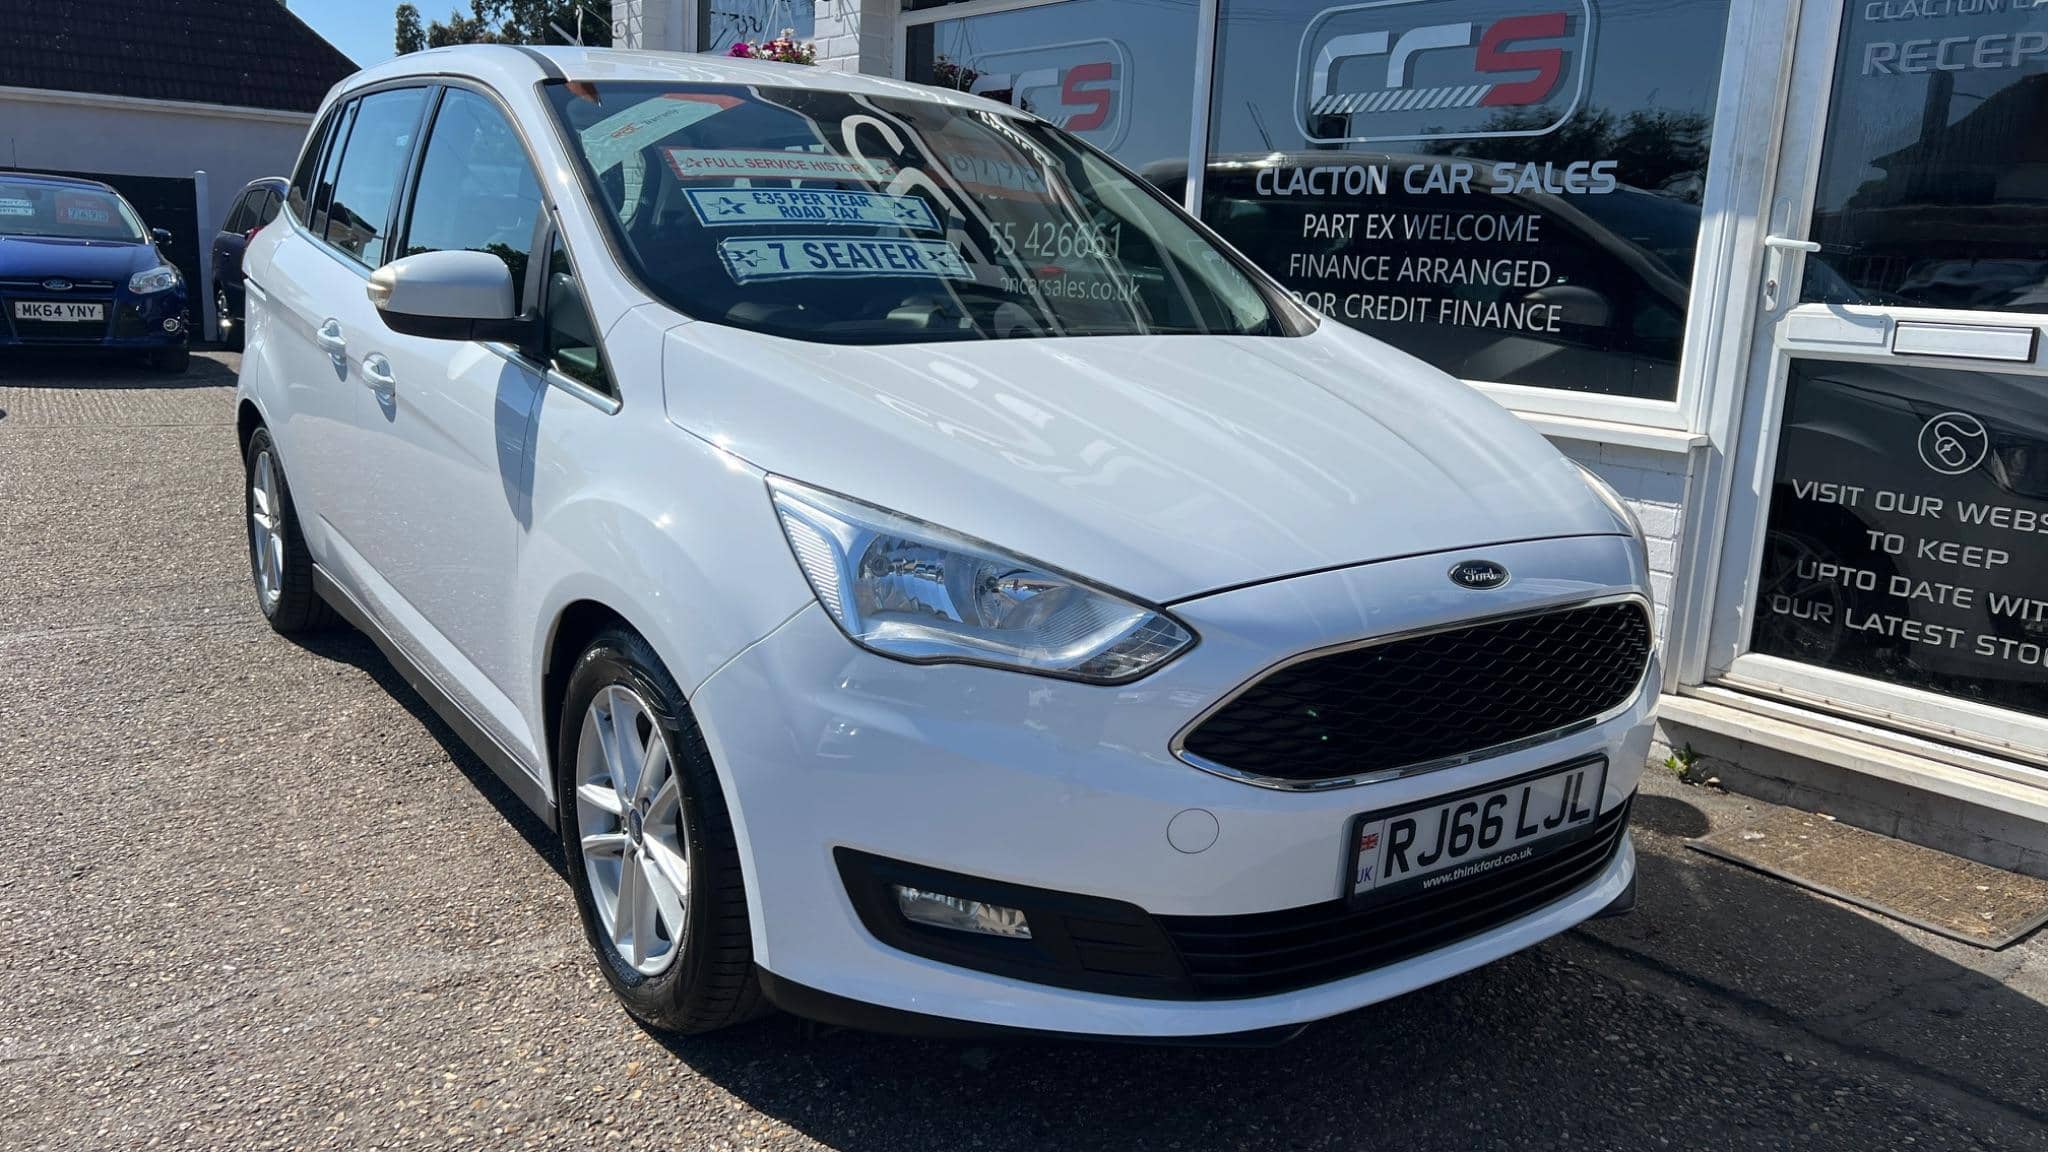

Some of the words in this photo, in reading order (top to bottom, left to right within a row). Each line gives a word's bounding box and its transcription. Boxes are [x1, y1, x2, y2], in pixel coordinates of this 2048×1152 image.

[1864, 0, 1999, 21] CLACTON
[1861, 31, 2048, 75] RECEP
[703, 157, 744, 169] FULL
[744, 158, 806, 171] SERVICE
[812, 160, 868, 175] HISTOR
[1255, 165, 1388, 196] CLACTON
[1403, 162, 1474, 195] CAR
[1491, 160, 1618, 194] SALES
[752, 193, 785, 205] £35
[790, 193, 821, 206] PER
[824, 194, 873, 208] YEAR
[779, 205, 826, 219] ROAD
[830, 206, 864, 220] TAX
[1024, 222, 1121, 259] 426661
[1303, 214, 1359, 239] PART
[1366, 214, 1395, 239] EX
[1403, 214, 1541, 242] WELCOME
[767, 243, 789, 270] 7
[803, 242, 928, 271] SEATER
[1289, 254, 1391, 281] FINANCE
[1397, 256, 1551, 287] ARRANGED
[22, 304, 62, 317] MK64
[67, 305, 96, 318] YNY
[1345, 294, 1431, 323] CREDIT
[1439, 299, 1563, 332] FINANCE
[1792, 478, 1864, 506] VISIT
[1875, 491, 1944, 519] OUR
[1866, 530, 1904, 555] TO
[1917, 538, 2009, 570] KEEP
[1797, 559, 1876, 590] UPTO
[1889, 575, 1974, 609] DATE
[1989, 592, 2048, 622] WIT
[1772, 595, 1833, 624] OUR
[1845, 608, 1965, 649] LATEST
[1975, 634, 2048, 668] STO
[1384, 794, 1508, 879] RJ66
[1515, 772, 1591, 840] LJL
[1356, 865, 1373, 884] UK
[1423, 847, 1533, 889] www.thinkford.co.uk
